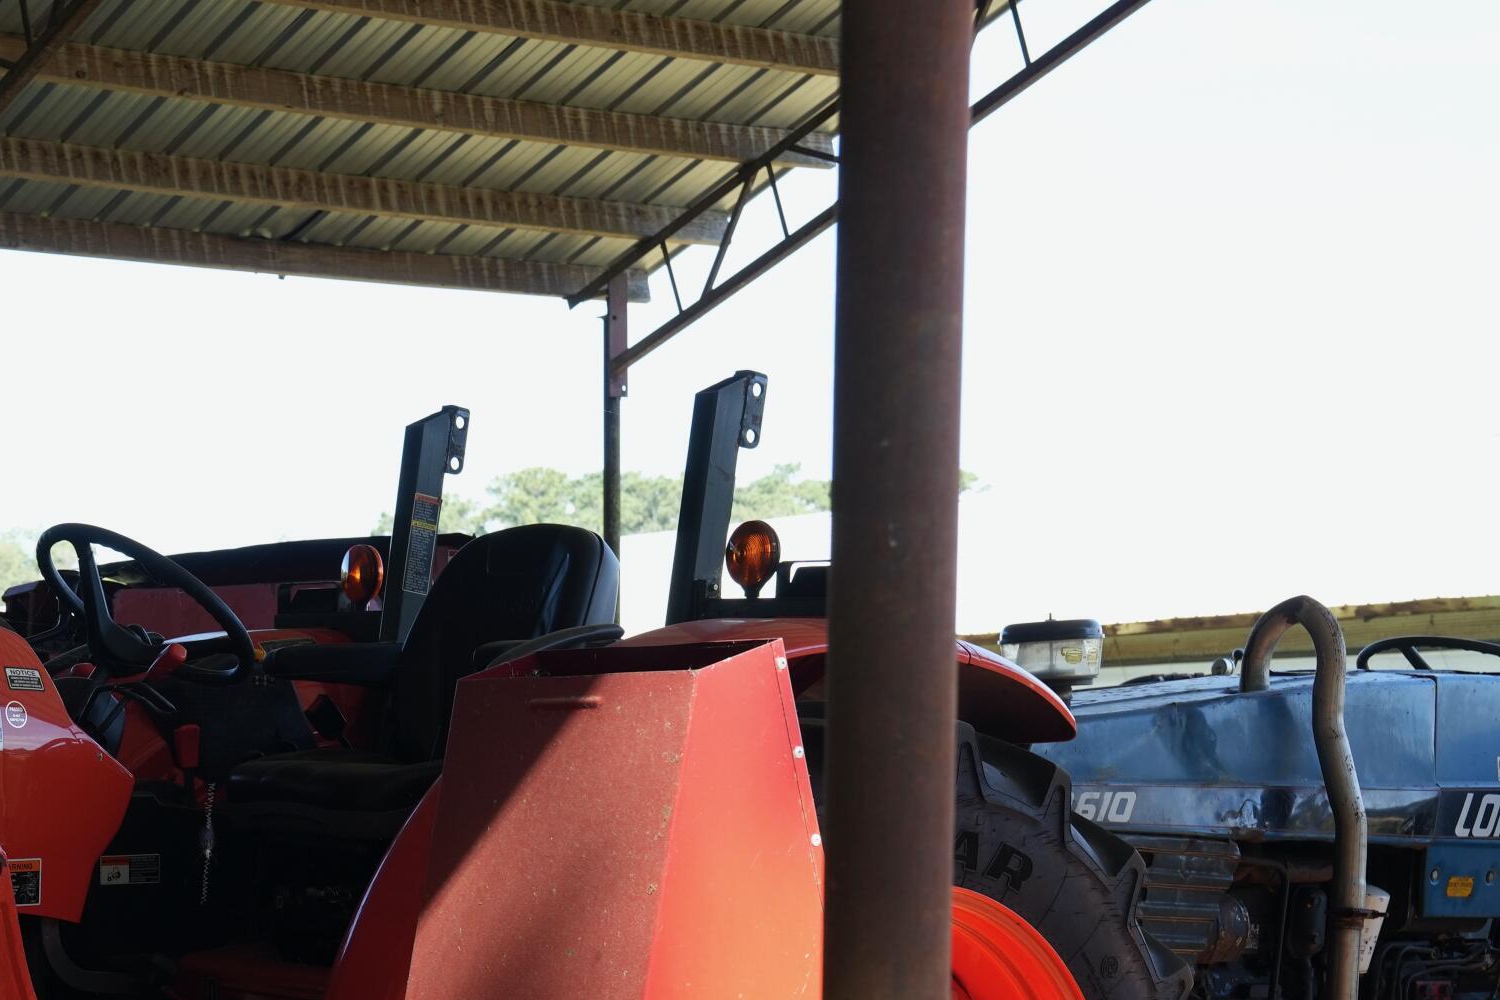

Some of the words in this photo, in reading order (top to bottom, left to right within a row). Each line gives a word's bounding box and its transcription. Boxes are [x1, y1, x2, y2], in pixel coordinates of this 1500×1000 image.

[9, 669, 37, 677] NOTICE
[1071, 791, 1136, 823] 610
[1455, 793, 1500, 838] LO
